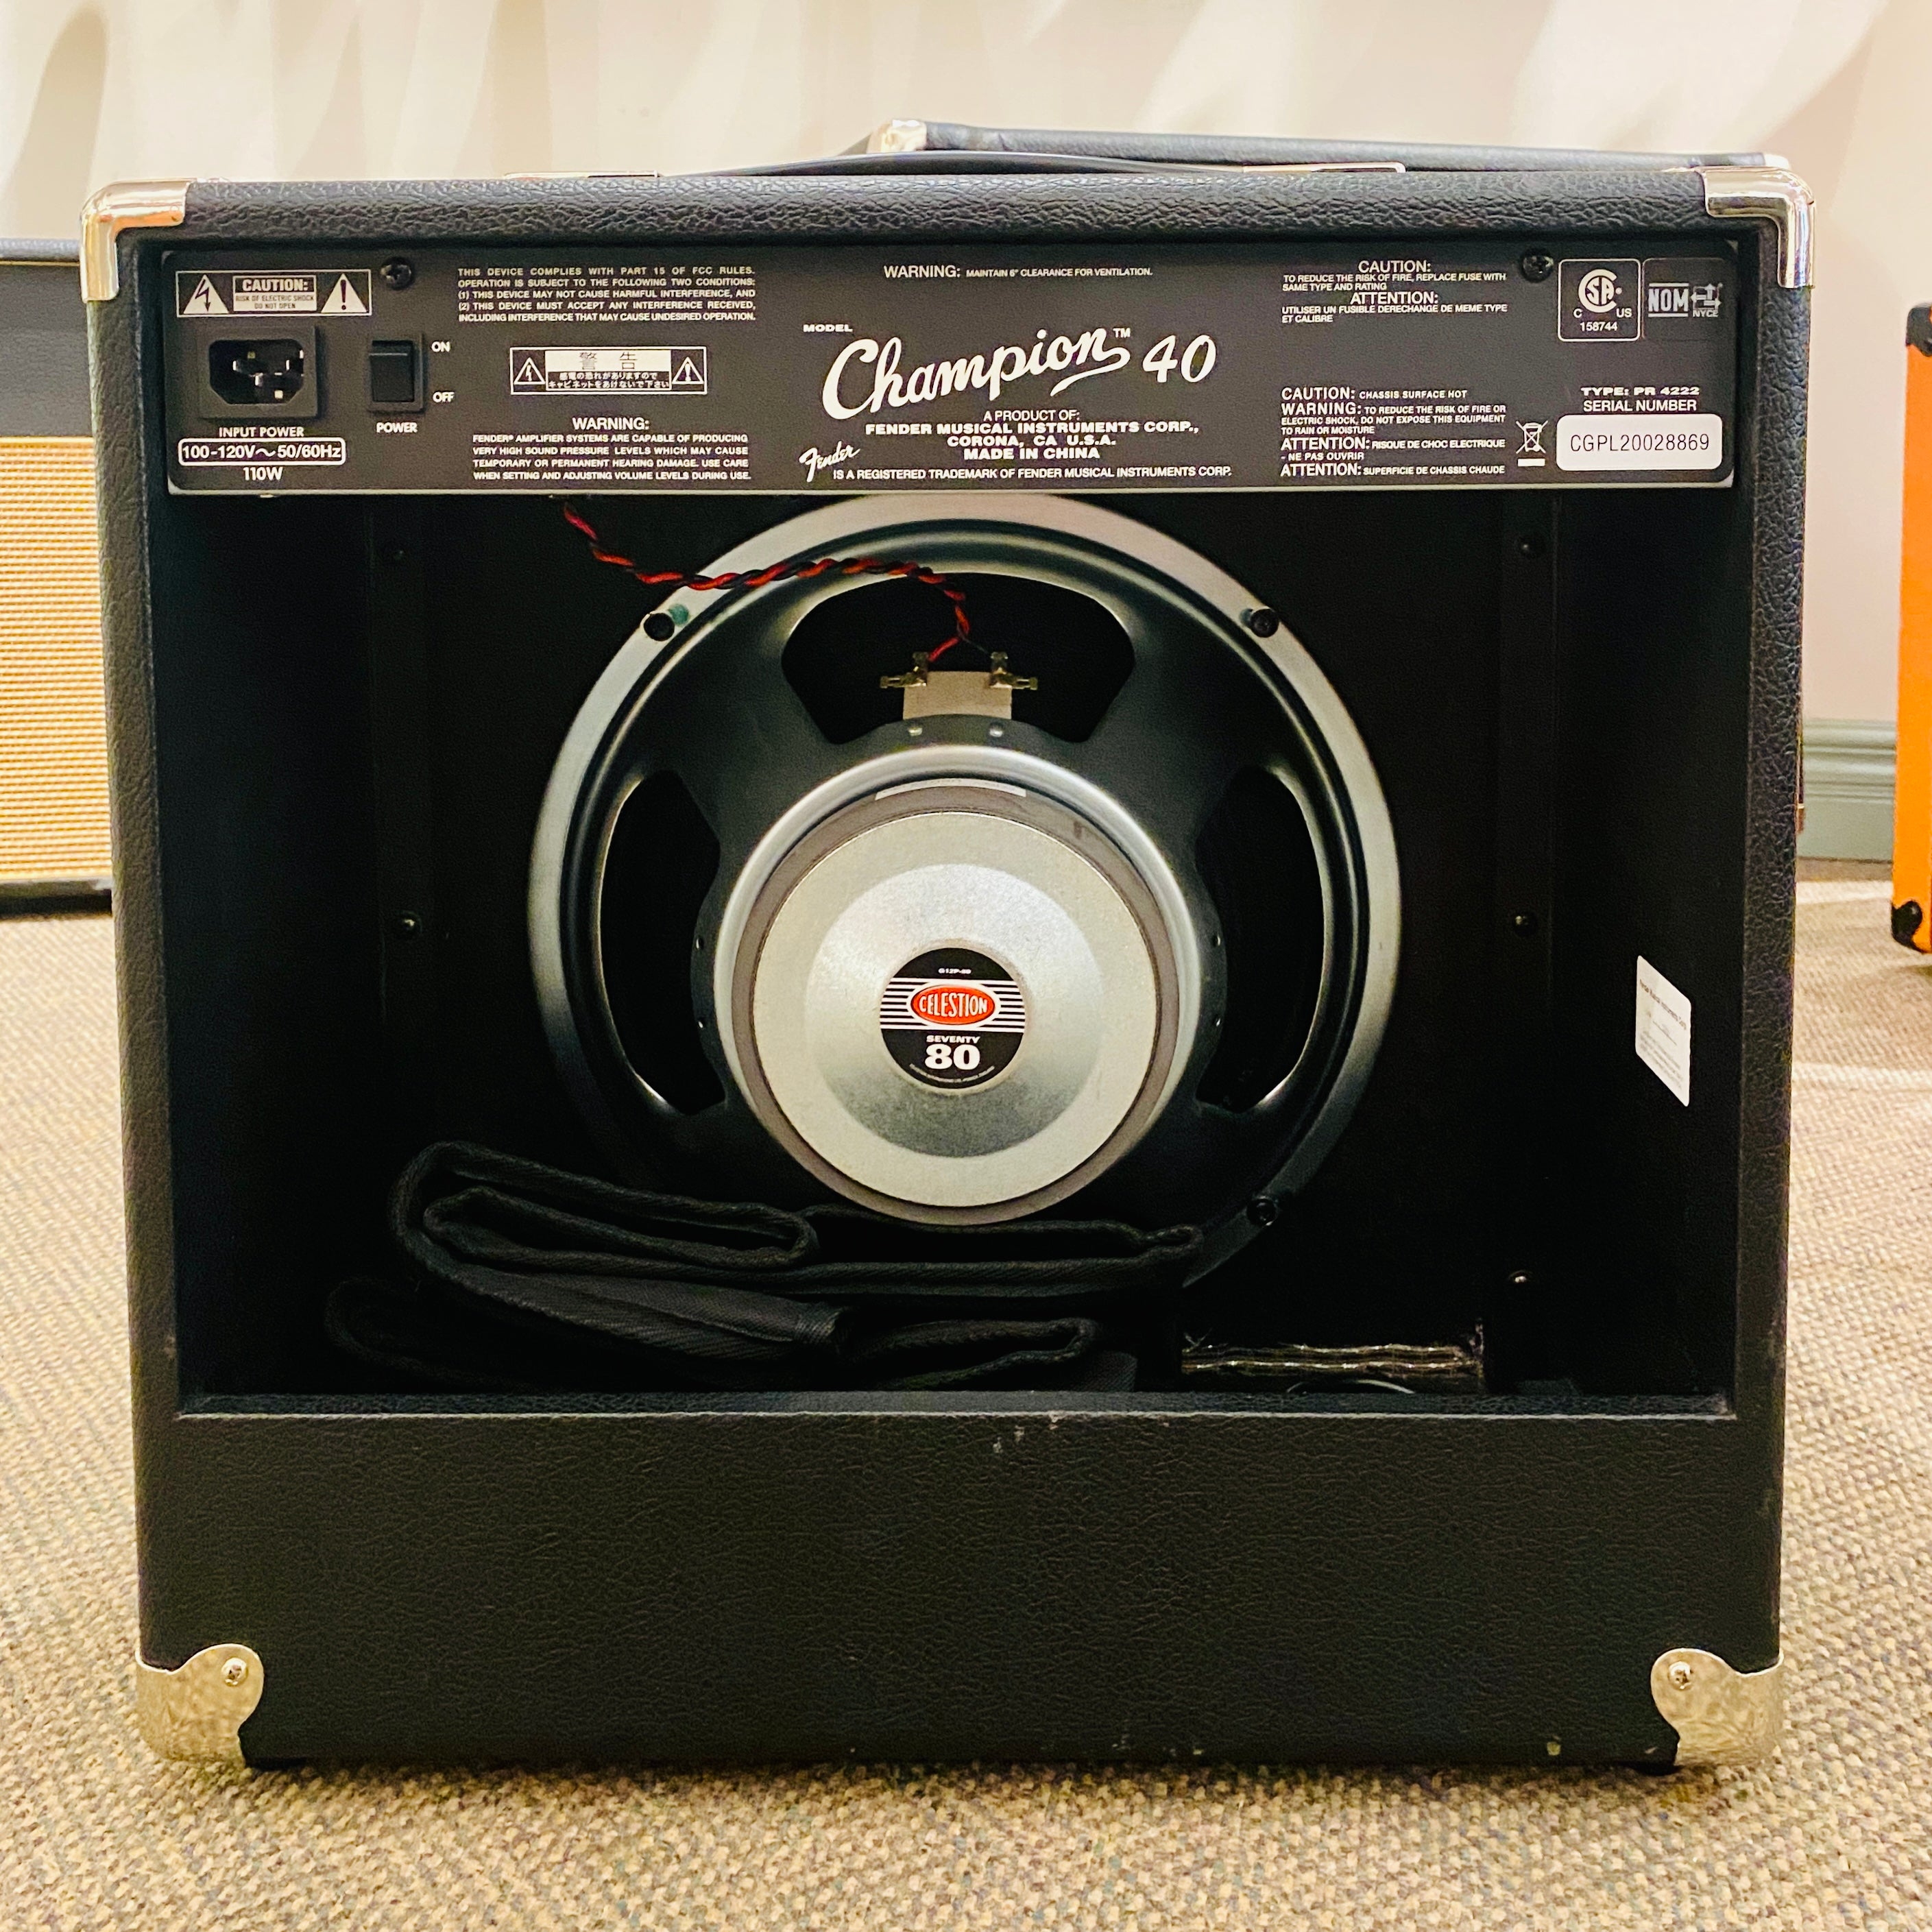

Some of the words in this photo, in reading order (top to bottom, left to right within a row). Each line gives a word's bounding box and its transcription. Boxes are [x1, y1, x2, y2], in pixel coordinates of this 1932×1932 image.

[530, 267, 581, 276] COMPLIES
[884, 265, 960, 278] WARNING:
[966, 268, 1008, 277] MAINTAIN
[1019, 268, 1073, 277] CLEARANCE
[1074, 267, 1093, 276] FOR
[1094, 267, 1152, 276] VENTILATION.
[1358, 260, 1430, 273] CAUTION:
[527, 278, 568, 287] SUBJECT
[572, 278, 585, 287] TO
[590, 278, 608, 287] THE
[1298, 274, 1334, 282] REDUCE
[1336, 274, 1353, 282] THE
[1458, 273, 1482, 281] FUSE
[243, 278, 307, 291] CAUTION:
[458, 291, 469, 299] (1)
[472, 291, 494, 299] THIS
[496, 291, 529, 299] DEVICE
[532, 290, 553, 298] MAY
[555, 290, 575, 298] NOT
[577, 290, 609, 298] CAUSE
[612, 290, 657, 298] HARMFUL
[735, 289, 755, 298] AND
[1351, 291, 1438, 304] ATTENTION:
[1648, 288, 1689, 312] NOM
[458, 302, 470, 311] (2)
[472, 302, 494, 311] THIS
[498, 302, 531, 311] DEVICE
[536, 302, 562, 311] MUST
[567, 302, 604, 311] ACCEPT
[608, 302, 628, 310] ANY
[632, 302, 702, 310] INTERFERENCE
[707, 301, 755, 310] RECEIVED,
[1281, 315, 1293, 323] ET
[1294, 314, 1332, 322] CALIBRE
[1616, 309, 1631, 318] US
[804, 324, 852, 333] MODEL
[1580, 322, 1617, 331] 158744
[431, 341, 450, 352] ON
[823, 328, 1130, 420] Champion
[1142, 335, 1216, 383] 40
[433, 392, 453, 402] OFF
[1281, 387, 1354, 400] CAUTION:
[1359, 390, 1399, 399] CHASSIS
[1402, 390, 1445, 399] SURFACE
[1447, 390, 1466, 398] HOT
[1580, 387, 1628, 396] TYPE:
[1633, 387, 1655, 396] PR
[1660, 387, 1699, 396] 4222
[1281, 402, 1361, 415] WARNING:
[1583, 400, 1632, 412] SERIAL
[1635, 400, 1696, 412] NUMBER
[983, 410, 992, 421] A
[994, 410, 1056, 421] PRODUCT
[1058, 409, 1079, 421] OF:
[1281, 416, 1323, 425] ELECTRIC
[1360, 416, 1373, 424] DO
[1376, 415, 1393, 424] NOT
[1396, 415, 1430, 424] EXPOSE
[1432, 415, 1452, 424] THIS
[1454, 415, 1505, 424] EQUIPMENT
[376, 423, 417, 433] POWER
[572, 417, 649, 430] WARNING:
[866, 424, 932, 435] FENDER
[937, 423, 1012, 435] MUSICAL
[1017, 422, 1139, 435] INSTRUMENTS
[1144, 422, 1198, 434] CORP.,
[219, 427, 256, 437] INPUT
[259, 426, 304, 437] POWER
[947, 435, 1024, 447] CORONA,
[1033, 435, 1056, 446] CA
[1066, 435, 1115, 446] U.S.A.
[1281, 436, 1369, 450] ATTENTION:
[1372, 440, 1405, 449] RISQUE
[1407, 440, 1419, 448] DE
[1421, 439, 1447, 448] CHOC
[1449, 439, 1505, 448] ELECTRIQUE
[1571, 433, 1708, 451] CGPL20028869
[964, 448, 1014, 461] MADE
[1019, 448, 1038, 460] IN
[1043, 447, 1099, 460] CHINA
[1288, 452, 1301, 461] NE
[1304, 452, 1324, 461] PAS
[1326, 452, 1364, 461] OUVRIR
[473, 459, 531, 468] TEMPORARY
[799, 440, 861, 483] Fender
[244, 467, 282, 481] 110W
[833, 469, 844, 479] IS
[846, 469, 854, 479] A
[857, 468, 926, 479] REGISTERED
[928, 468, 997, 479] TRADEMARK
[1000, 468, 1015, 479] OF
[1017, 468, 1062, 478] FENDER
[1064, 467, 1114, 478] MUSICAL
[1116, 466, 1196, 477] INSTRUMENTS
[1198, 466, 1231, 477] CORP.
[1281, 463, 1360, 476] ATTENTION:
[919, 992, 988, 1017] CELESTION
[927, 1035, 979, 1043] SEVENTY
[924, 1043, 980, 1070] 80
